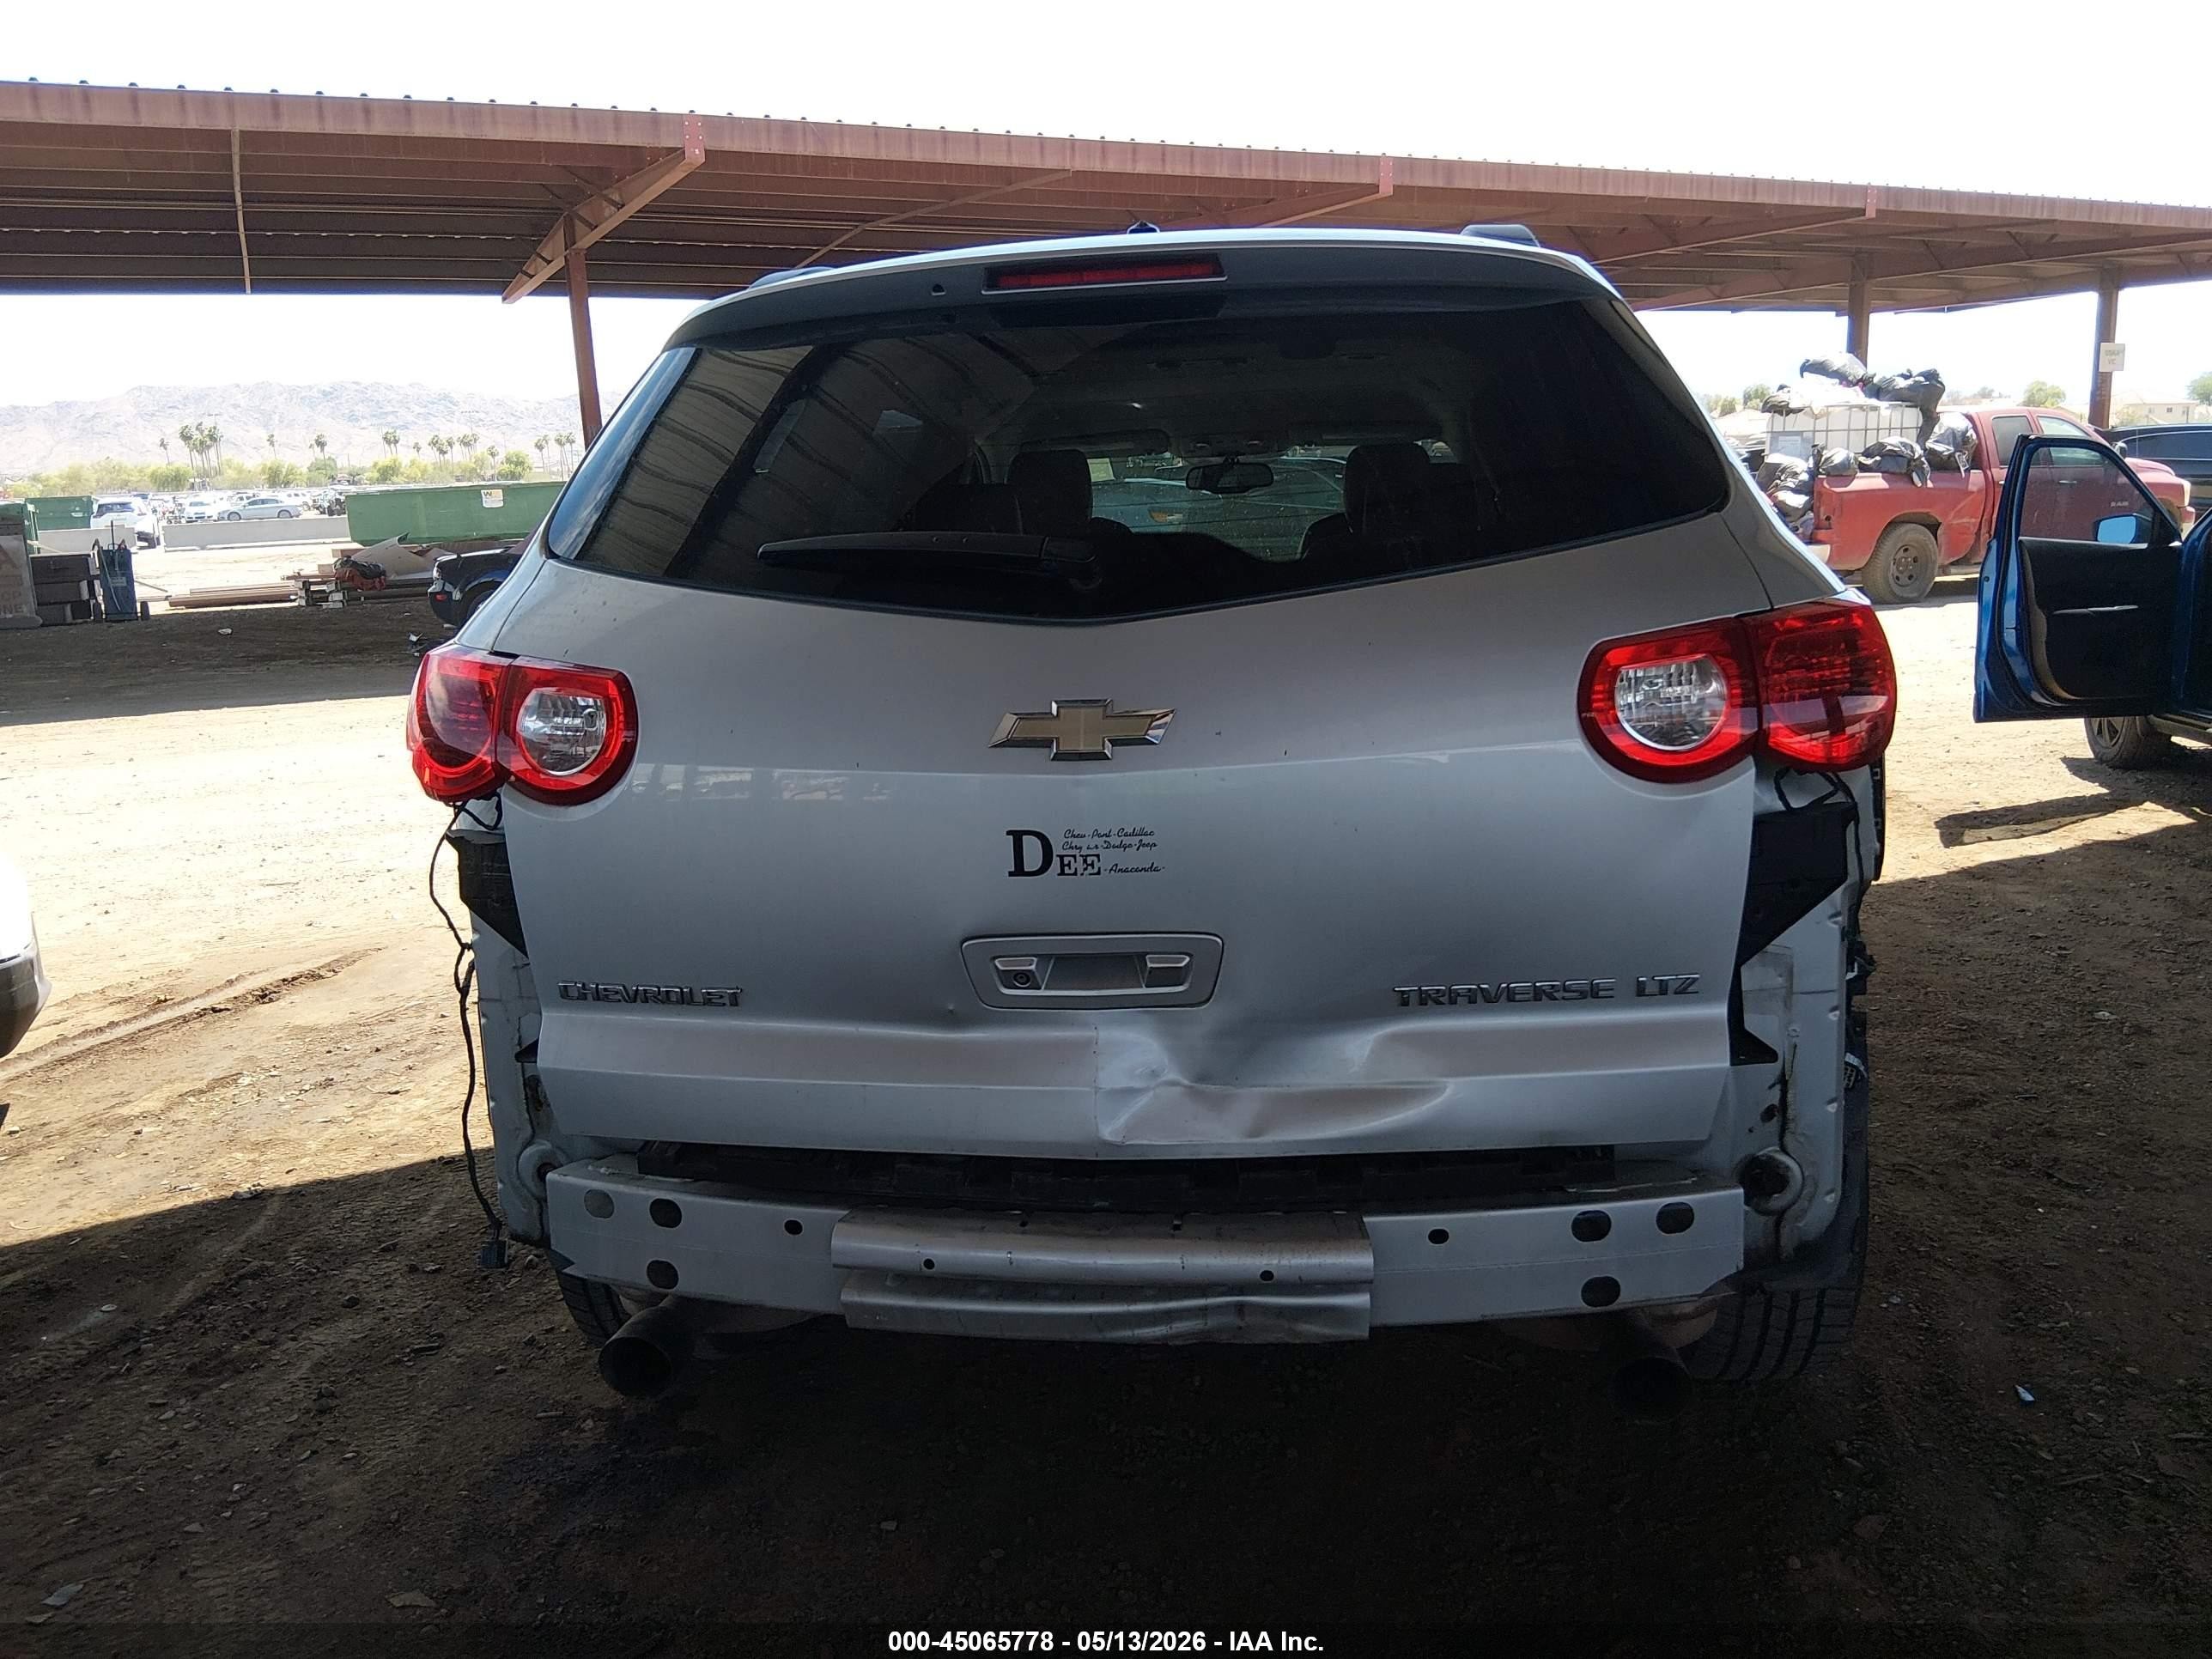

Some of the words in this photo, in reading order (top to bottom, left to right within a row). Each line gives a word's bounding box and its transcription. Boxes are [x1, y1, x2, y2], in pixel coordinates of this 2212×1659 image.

[558, 981, 743, 1007] CHEVROLET
[1394, 978, 1617, 1006] TRAVERSE
[1636, 973, 1701, 998] LTZ
